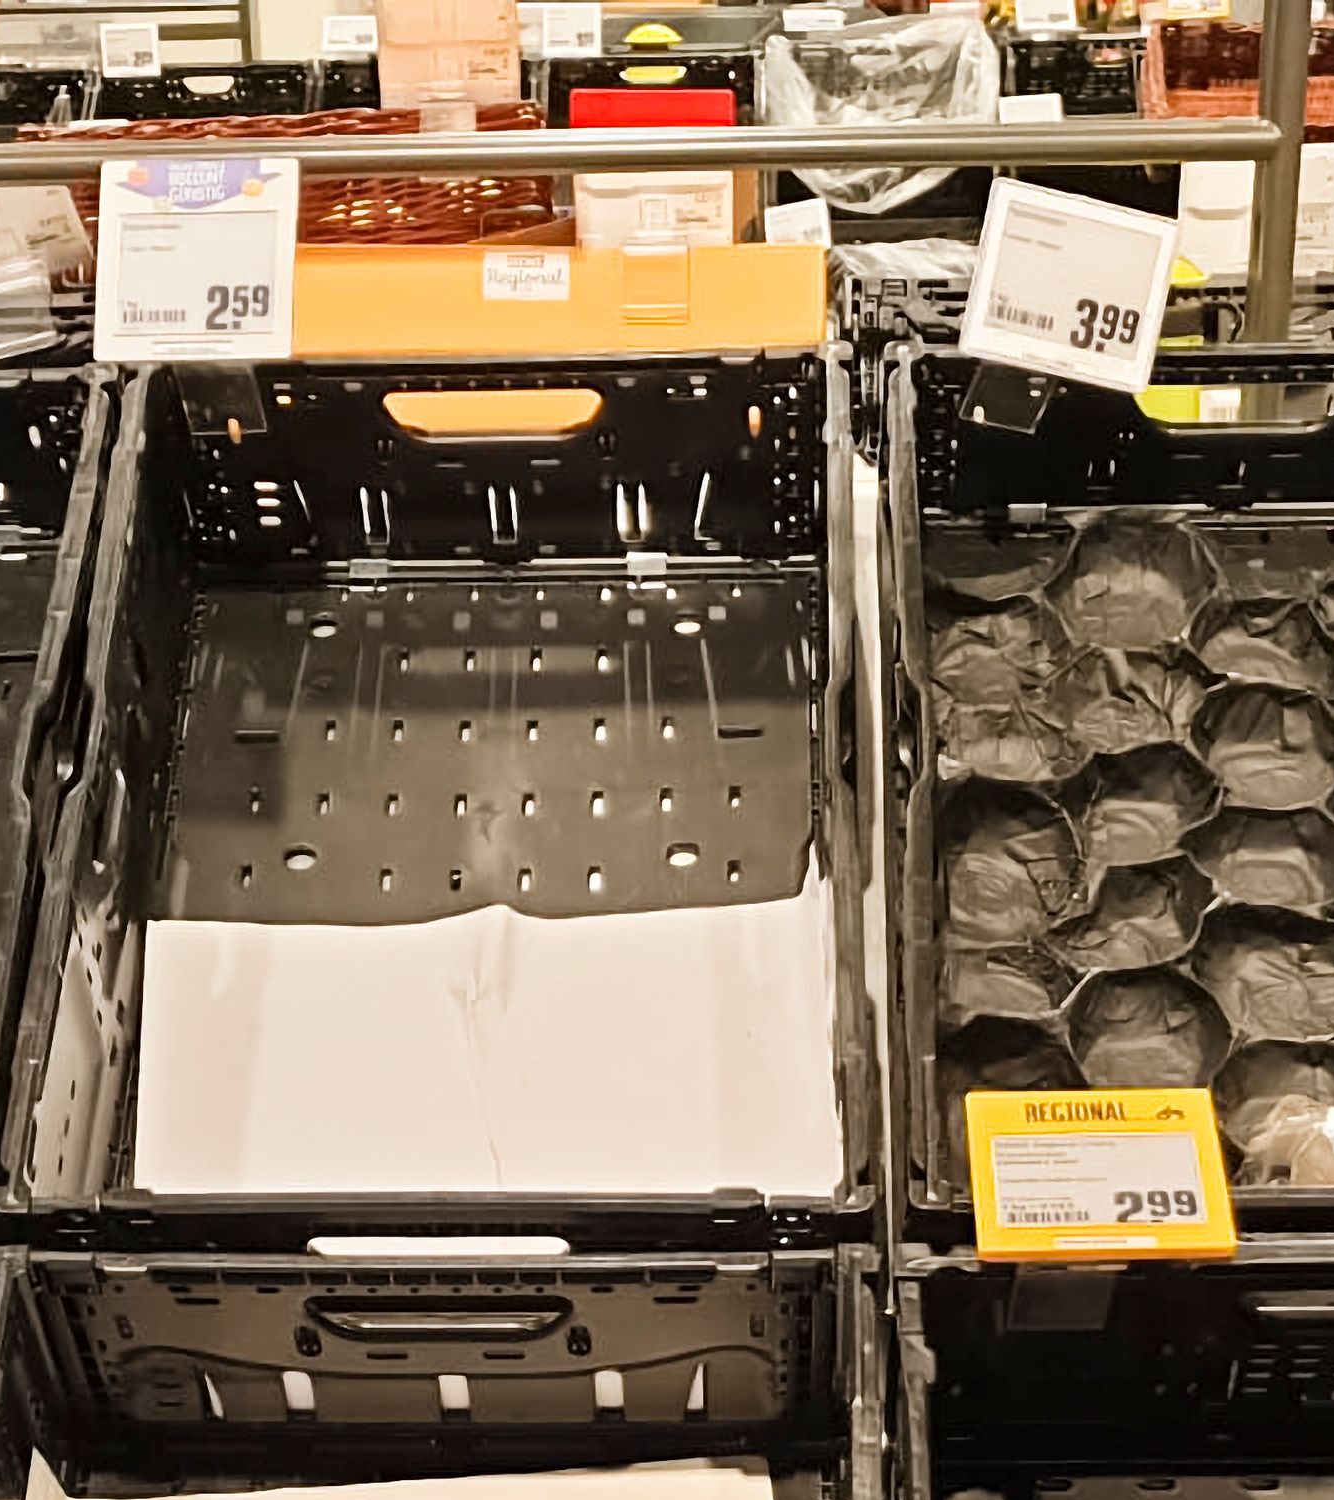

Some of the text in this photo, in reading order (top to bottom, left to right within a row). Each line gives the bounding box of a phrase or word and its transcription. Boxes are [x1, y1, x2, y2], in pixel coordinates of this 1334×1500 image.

[487, 267, 565, 292] Regional
[205, 285, 270, 330] 2.59
[1070, 298, 1140, 352] 3.99
[1024, 1102, 1127, 1122] REGIONAL
